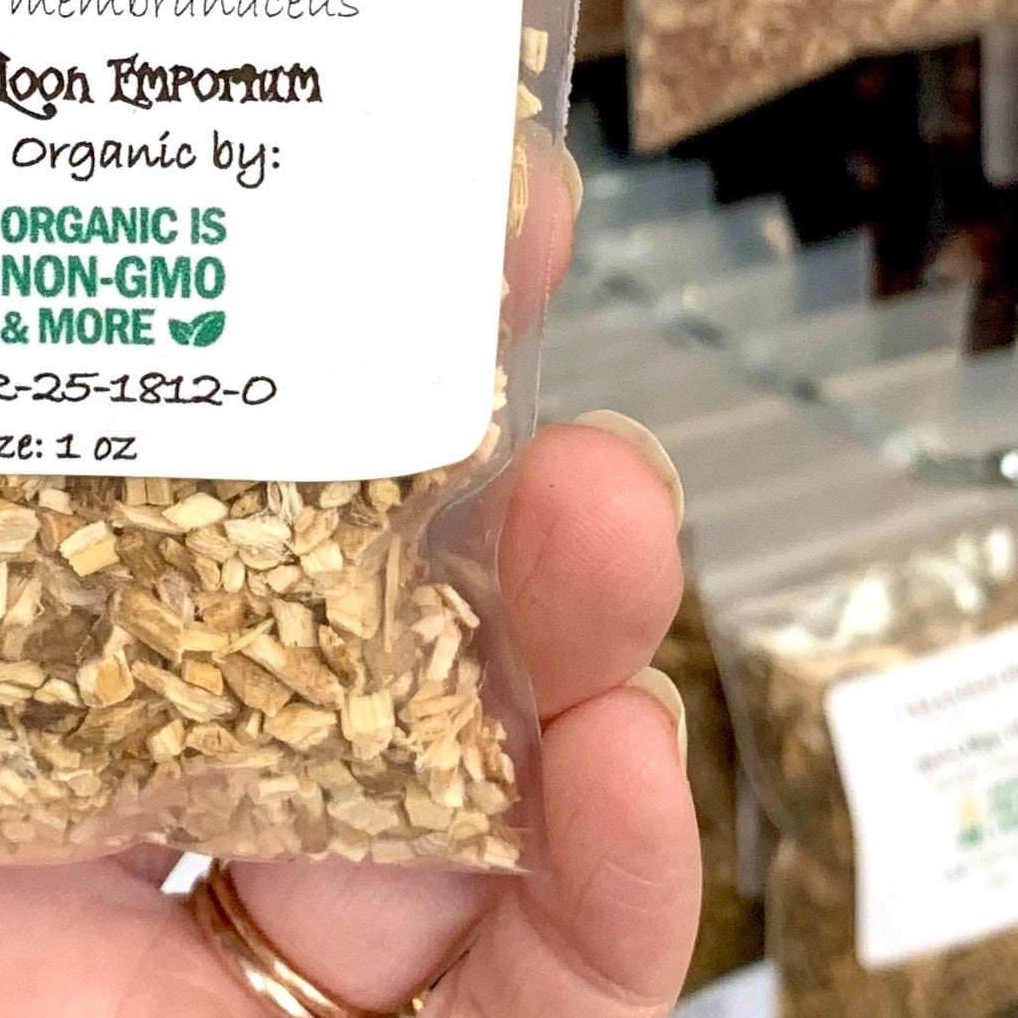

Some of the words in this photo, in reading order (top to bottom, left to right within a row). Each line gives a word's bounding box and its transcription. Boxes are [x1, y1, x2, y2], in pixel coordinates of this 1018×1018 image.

[11, 130, 197, 182] Organic
[212, 129, 281, 190] by:
[0, 205, 178, 245] ORGANIC
[190, 206, 227, 245] IS
[0, 254, 227, 300] NON-GMO
[0, 310, 29, 346] &
[38, 307, 156, 346] MORE
[55, 433, 82, 460] 1
[93, 436, 139, 462] oz
